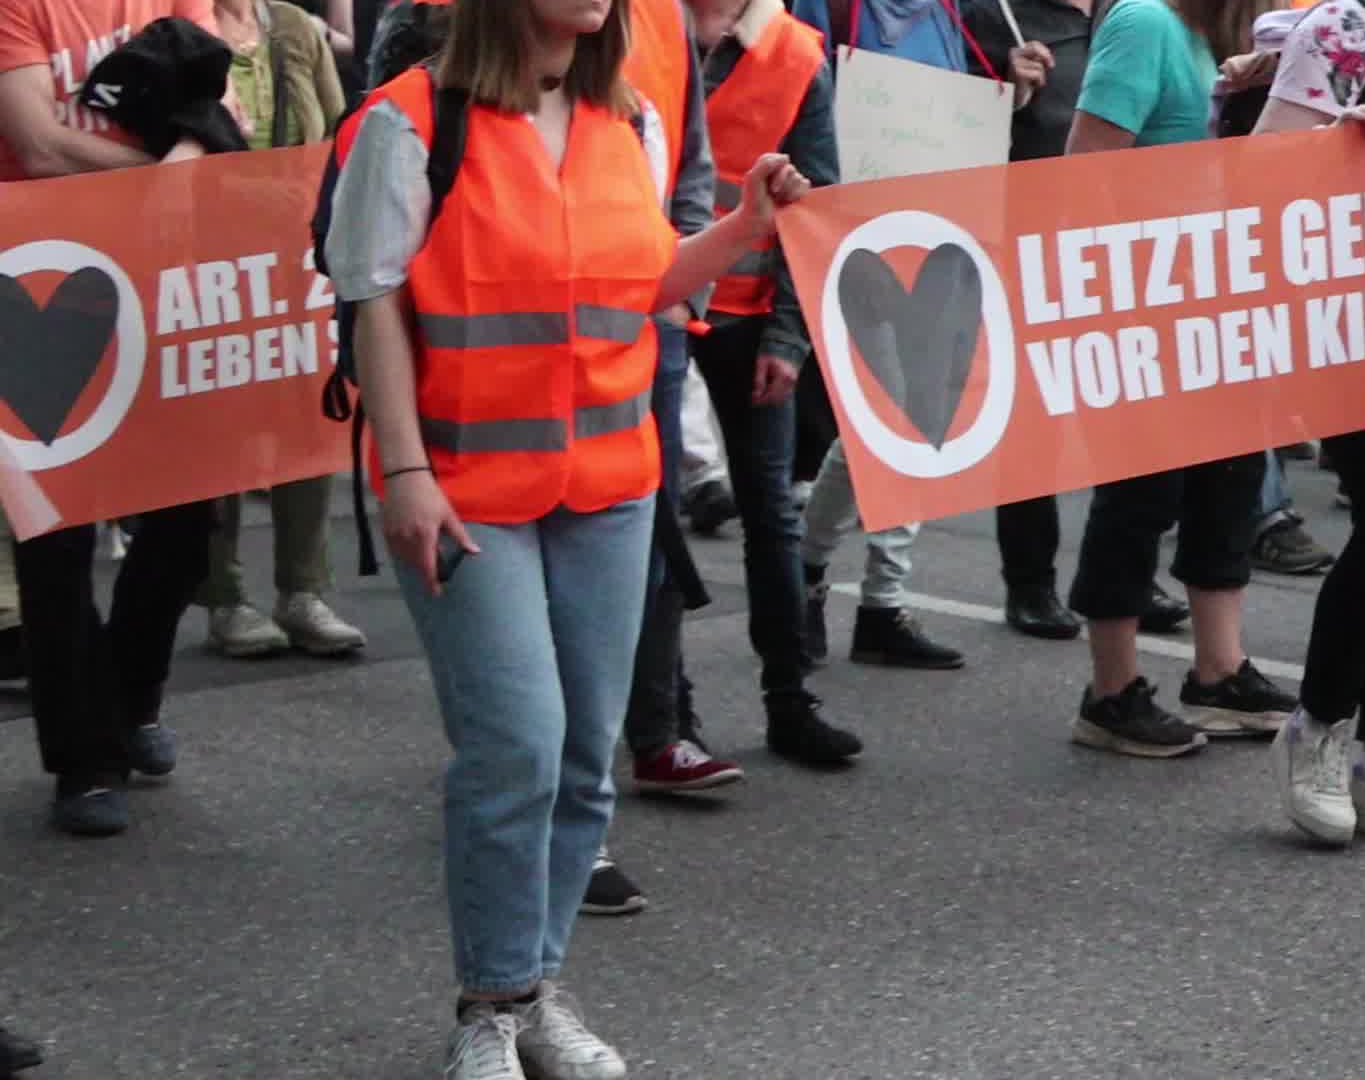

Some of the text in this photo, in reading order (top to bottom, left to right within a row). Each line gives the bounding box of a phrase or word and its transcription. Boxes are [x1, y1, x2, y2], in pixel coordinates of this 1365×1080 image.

[156, 252, 289, 337] ART.
[1017, 206, 1266, 325] LETZTE
[160, 320, 319, 400] LEBEN
[1025, 325, 1165, 417] VOR
[1175, 303, 1294, 393] DEN
